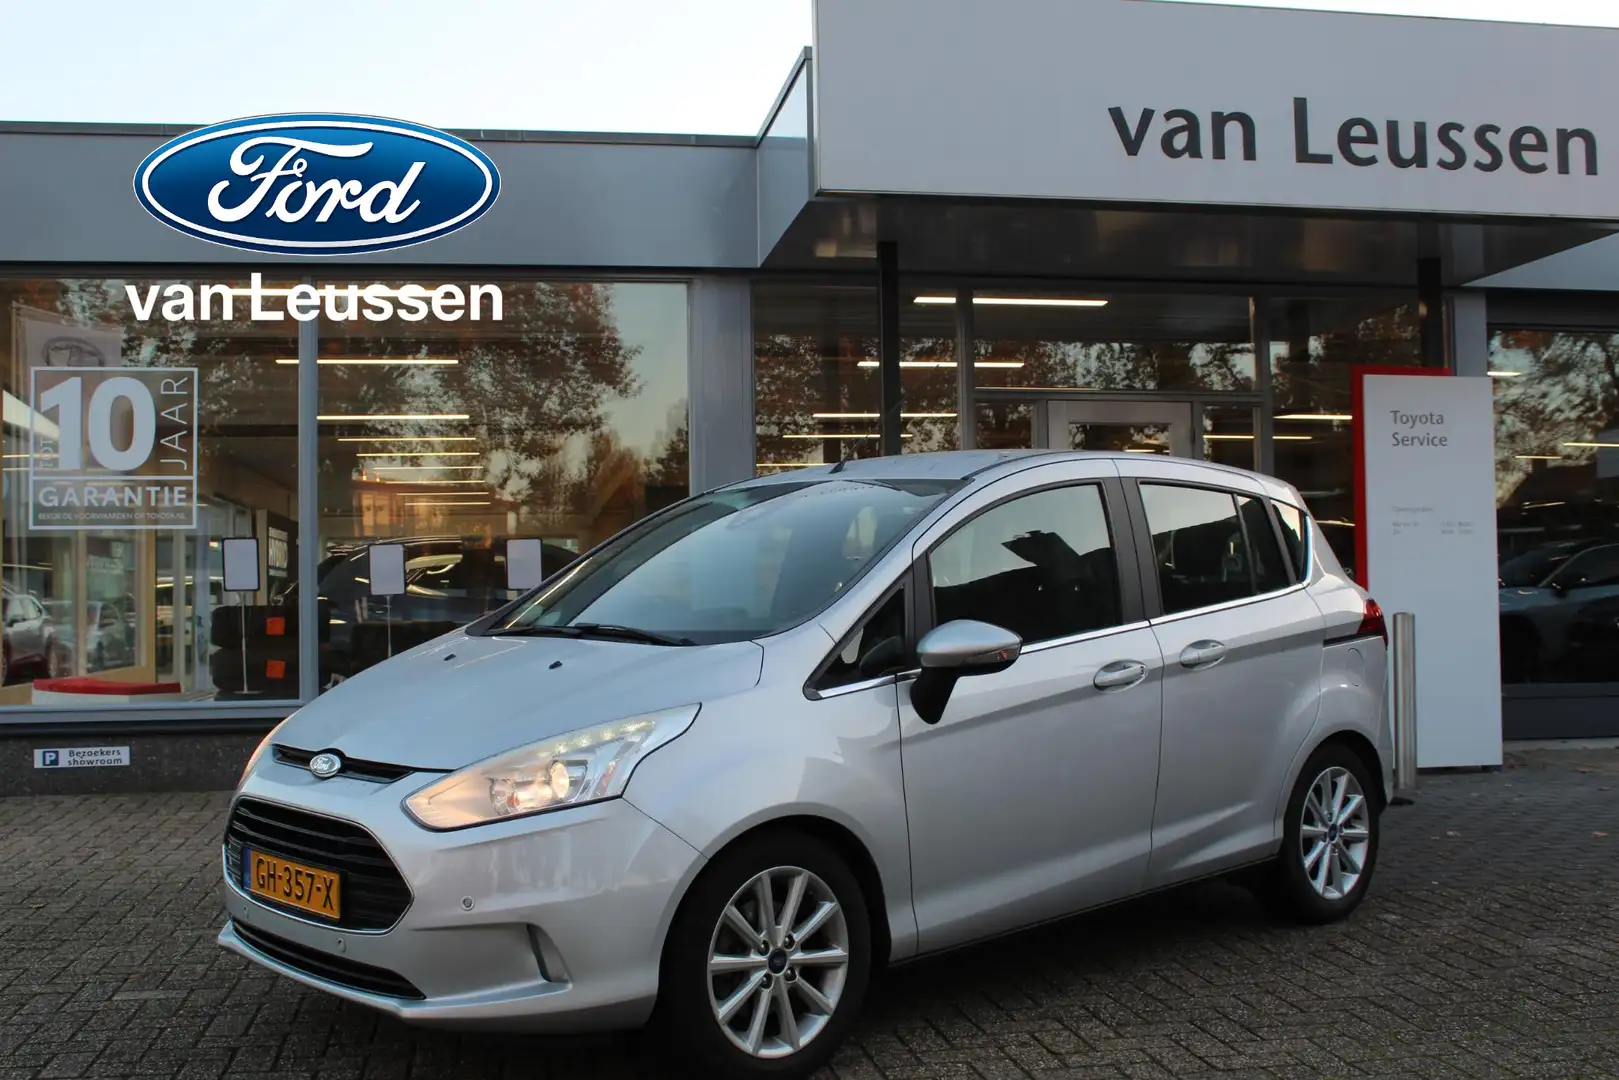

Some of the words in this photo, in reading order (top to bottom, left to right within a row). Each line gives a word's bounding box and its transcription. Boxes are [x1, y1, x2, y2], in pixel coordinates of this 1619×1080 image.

[1107, 105, 1257, 162] van
[1293, 96, 1598, 176] Leussen
[40, 376, 156, 471] 10
[160, 376, 188, 471] JAAR
[1390, 410, 1444, 429] Toyota
[1392, 432, 1448, 447] Service
[38, 486, 187, 507] GARANTIE
[45, 752, 56, 765] P
[67, 757, 122, 766] showroom
[68, 749, 121, 757] Bezoekers
[256, 857, 335, 911] GH-357-X
